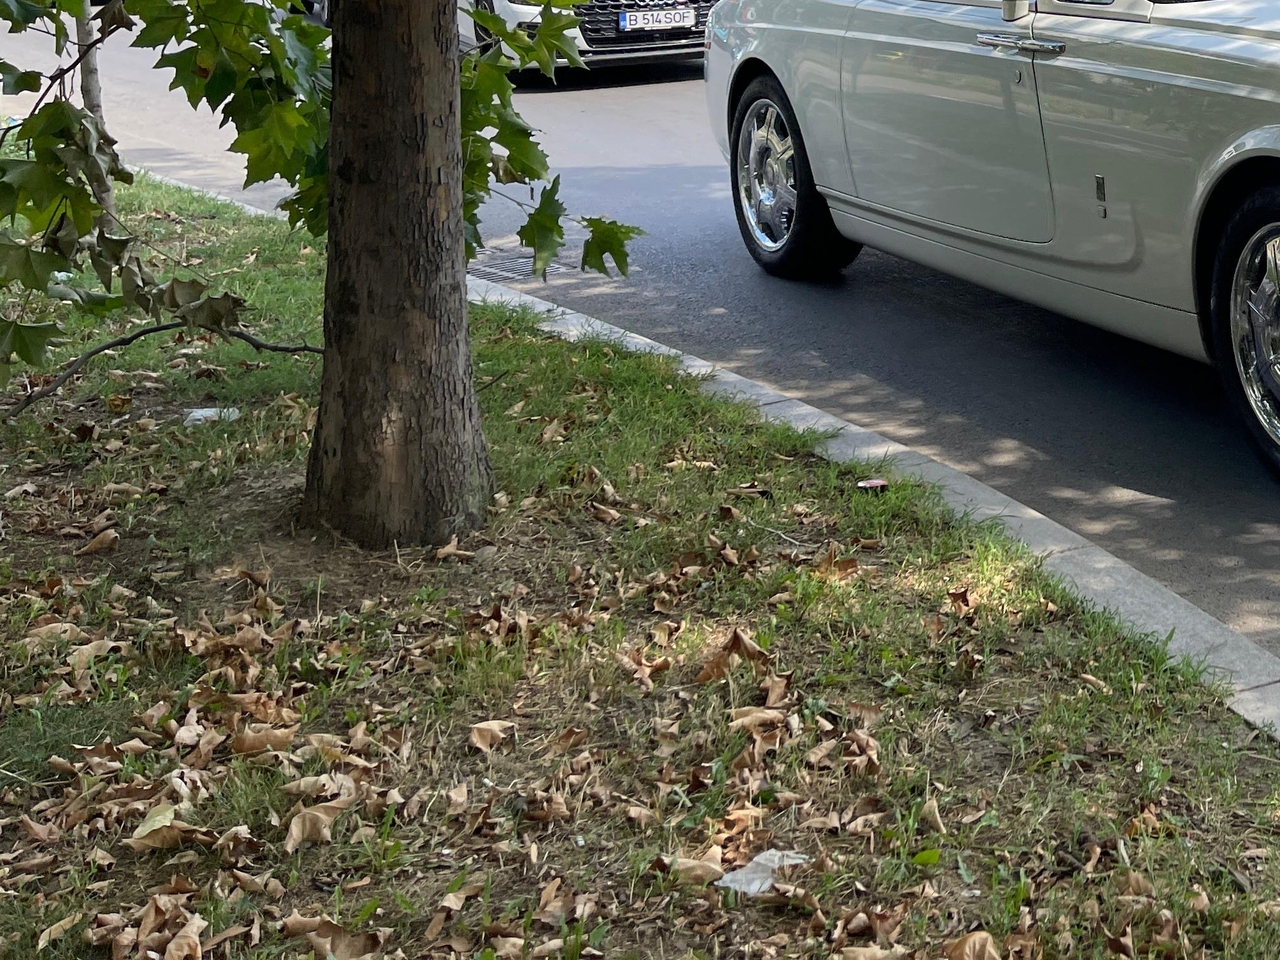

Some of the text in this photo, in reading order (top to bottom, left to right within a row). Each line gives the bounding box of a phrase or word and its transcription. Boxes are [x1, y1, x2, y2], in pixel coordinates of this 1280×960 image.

[629, 14, 638, 26] B
[642, 13, 662, 25] 514
[664, 11, 691, 24] SOF
